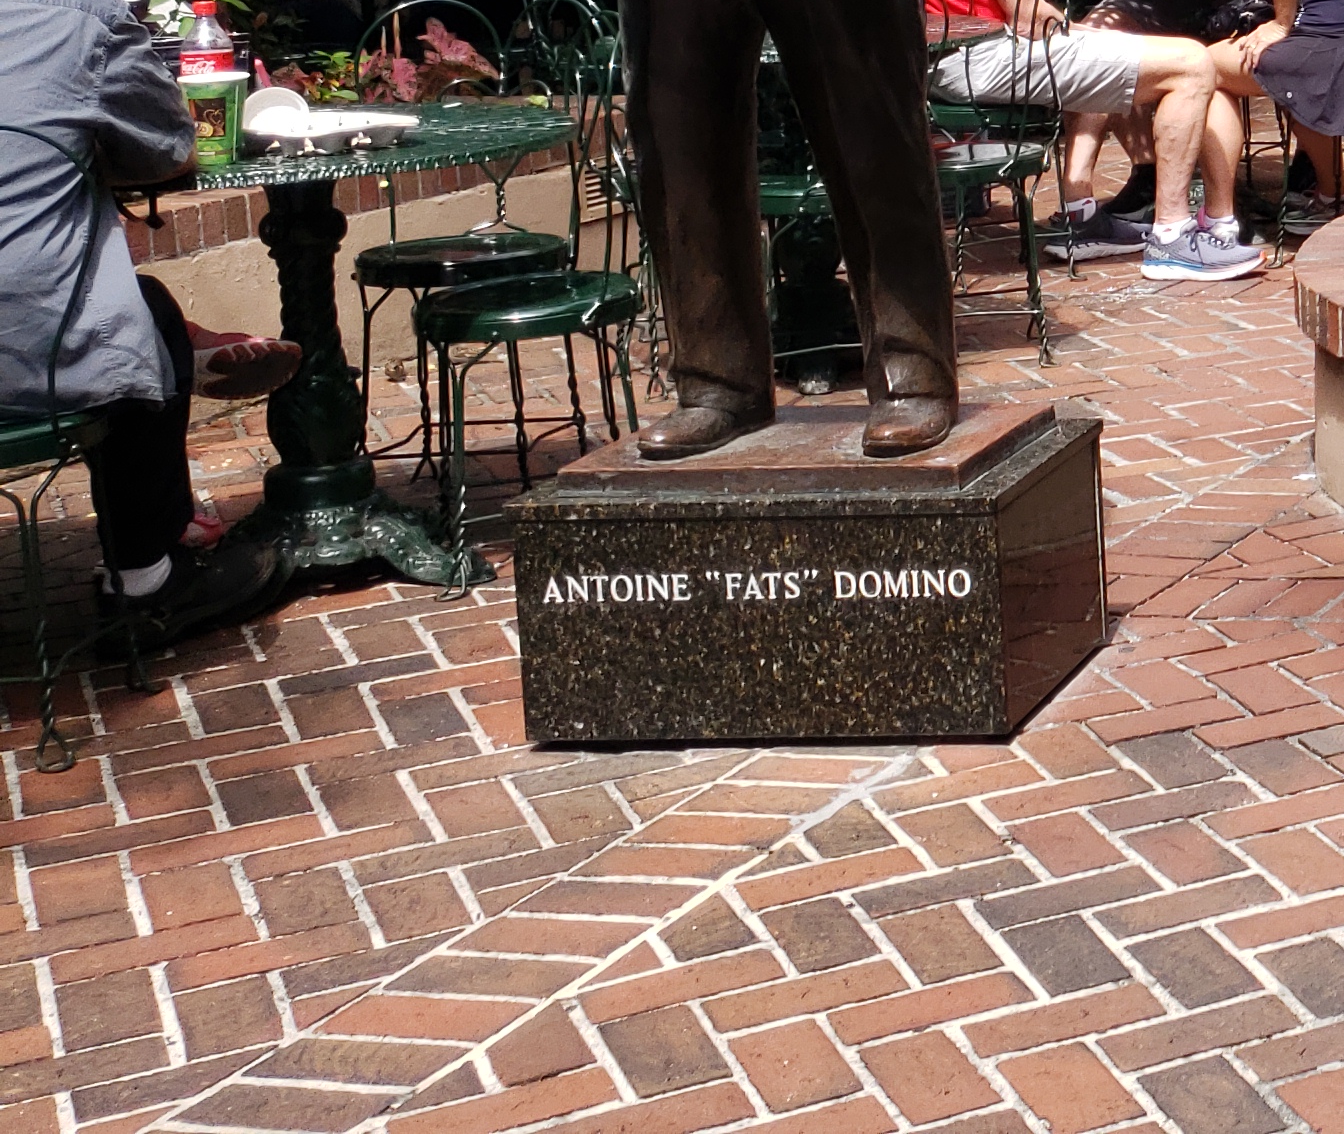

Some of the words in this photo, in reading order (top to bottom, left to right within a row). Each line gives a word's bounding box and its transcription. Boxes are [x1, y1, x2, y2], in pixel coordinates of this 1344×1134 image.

[543, 573, 692, 604] ANTOINE
[705, 569, 818, 601] "FATS"
[833, 569, 972, 600] DOMINO
